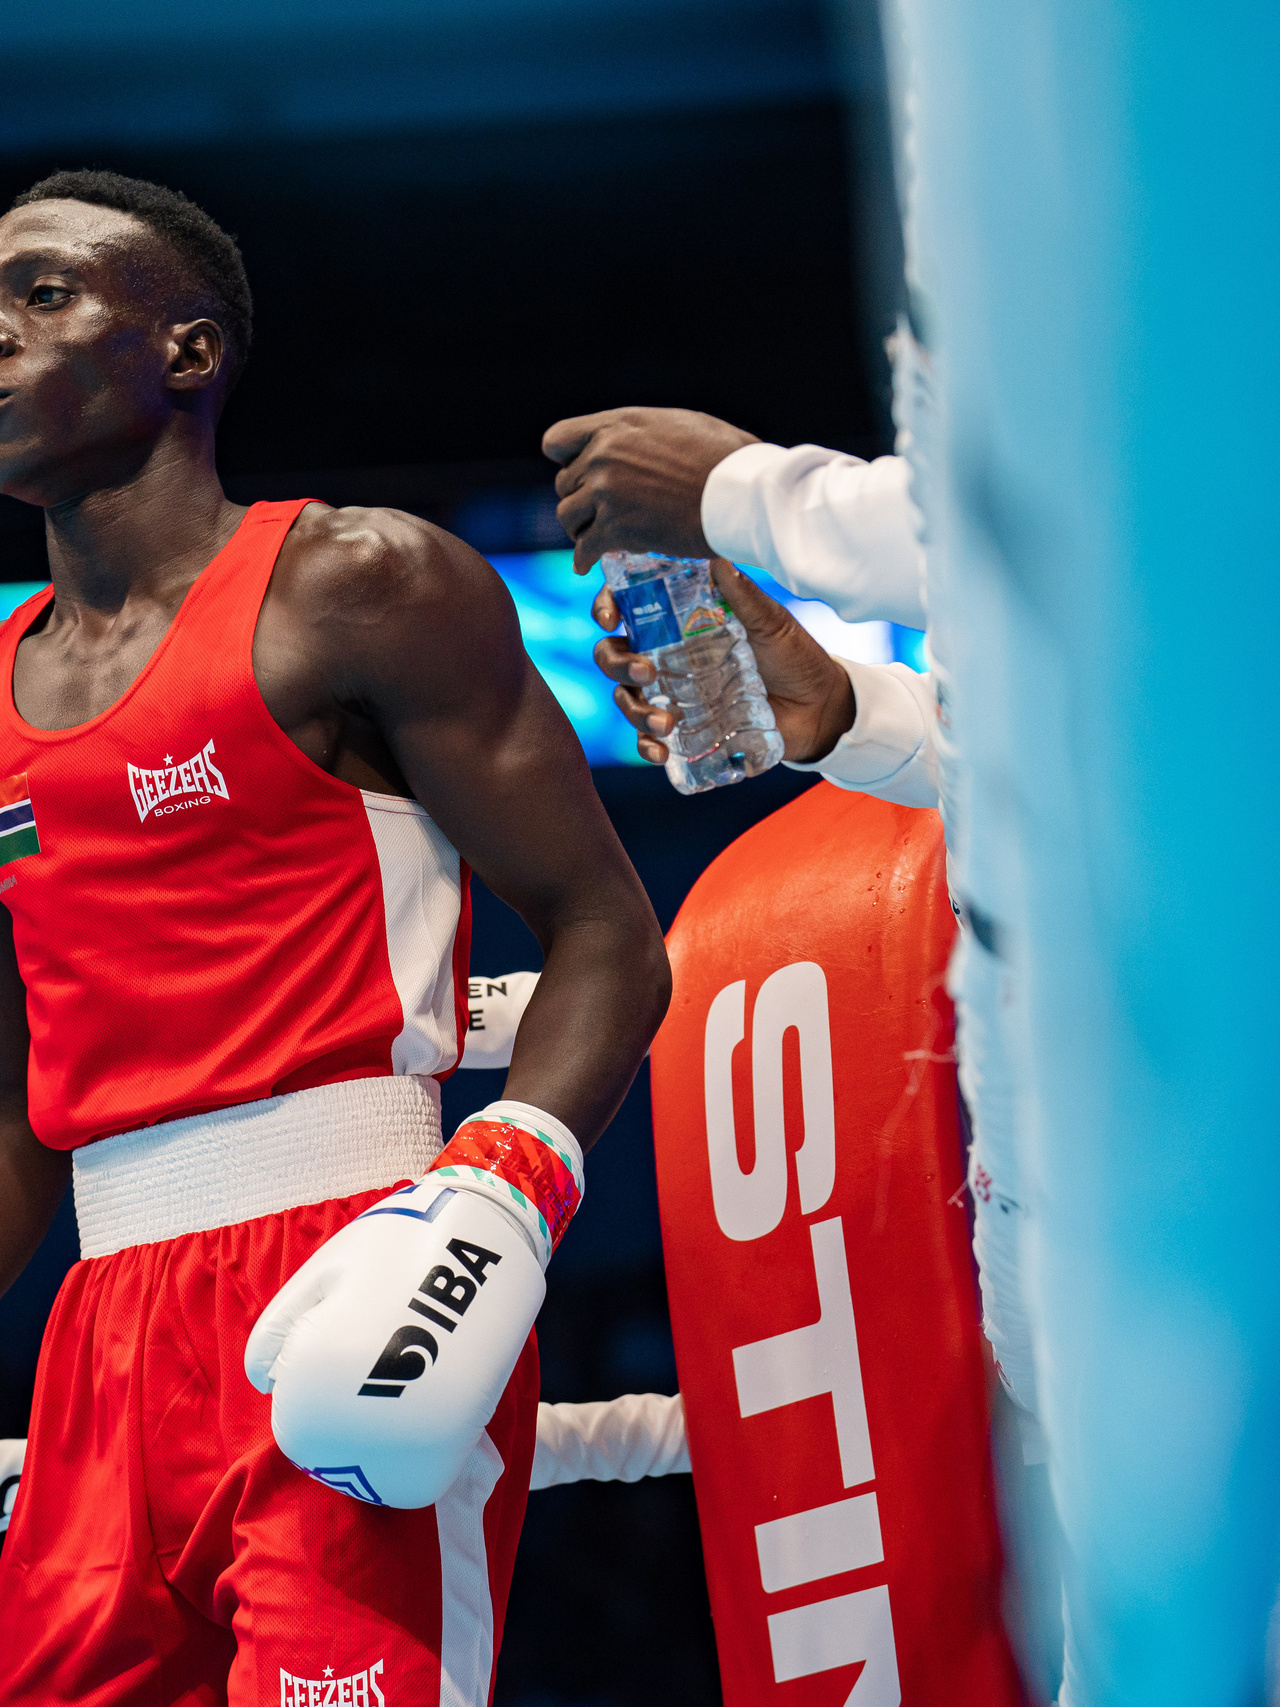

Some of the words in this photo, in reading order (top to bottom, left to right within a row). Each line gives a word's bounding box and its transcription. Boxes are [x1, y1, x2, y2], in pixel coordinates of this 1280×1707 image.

[127, 738, 229, 823] GEEZERS
[154, 796, 211, 817] BOXING
[408, 1237, 503, 1334] IBA
[280, 1658, 385, 1707] GEEZERS
